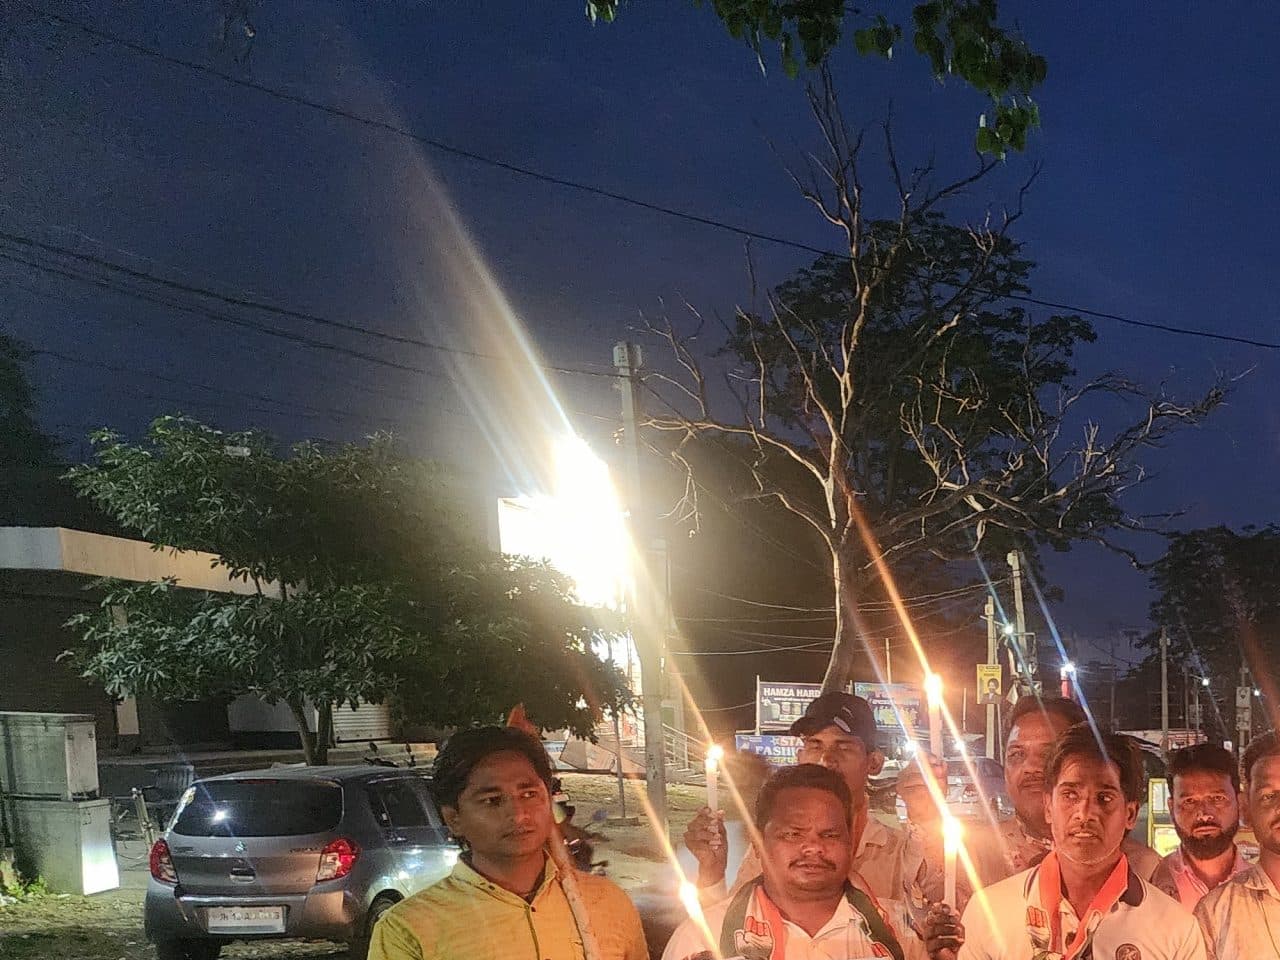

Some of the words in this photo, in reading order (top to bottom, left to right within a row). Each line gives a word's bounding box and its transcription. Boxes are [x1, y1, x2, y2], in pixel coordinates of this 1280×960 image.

[763, 687, 795, 698] HAMZA
[796, 688, 823, 698] HARD
[779, 736, 806, 747] STA
